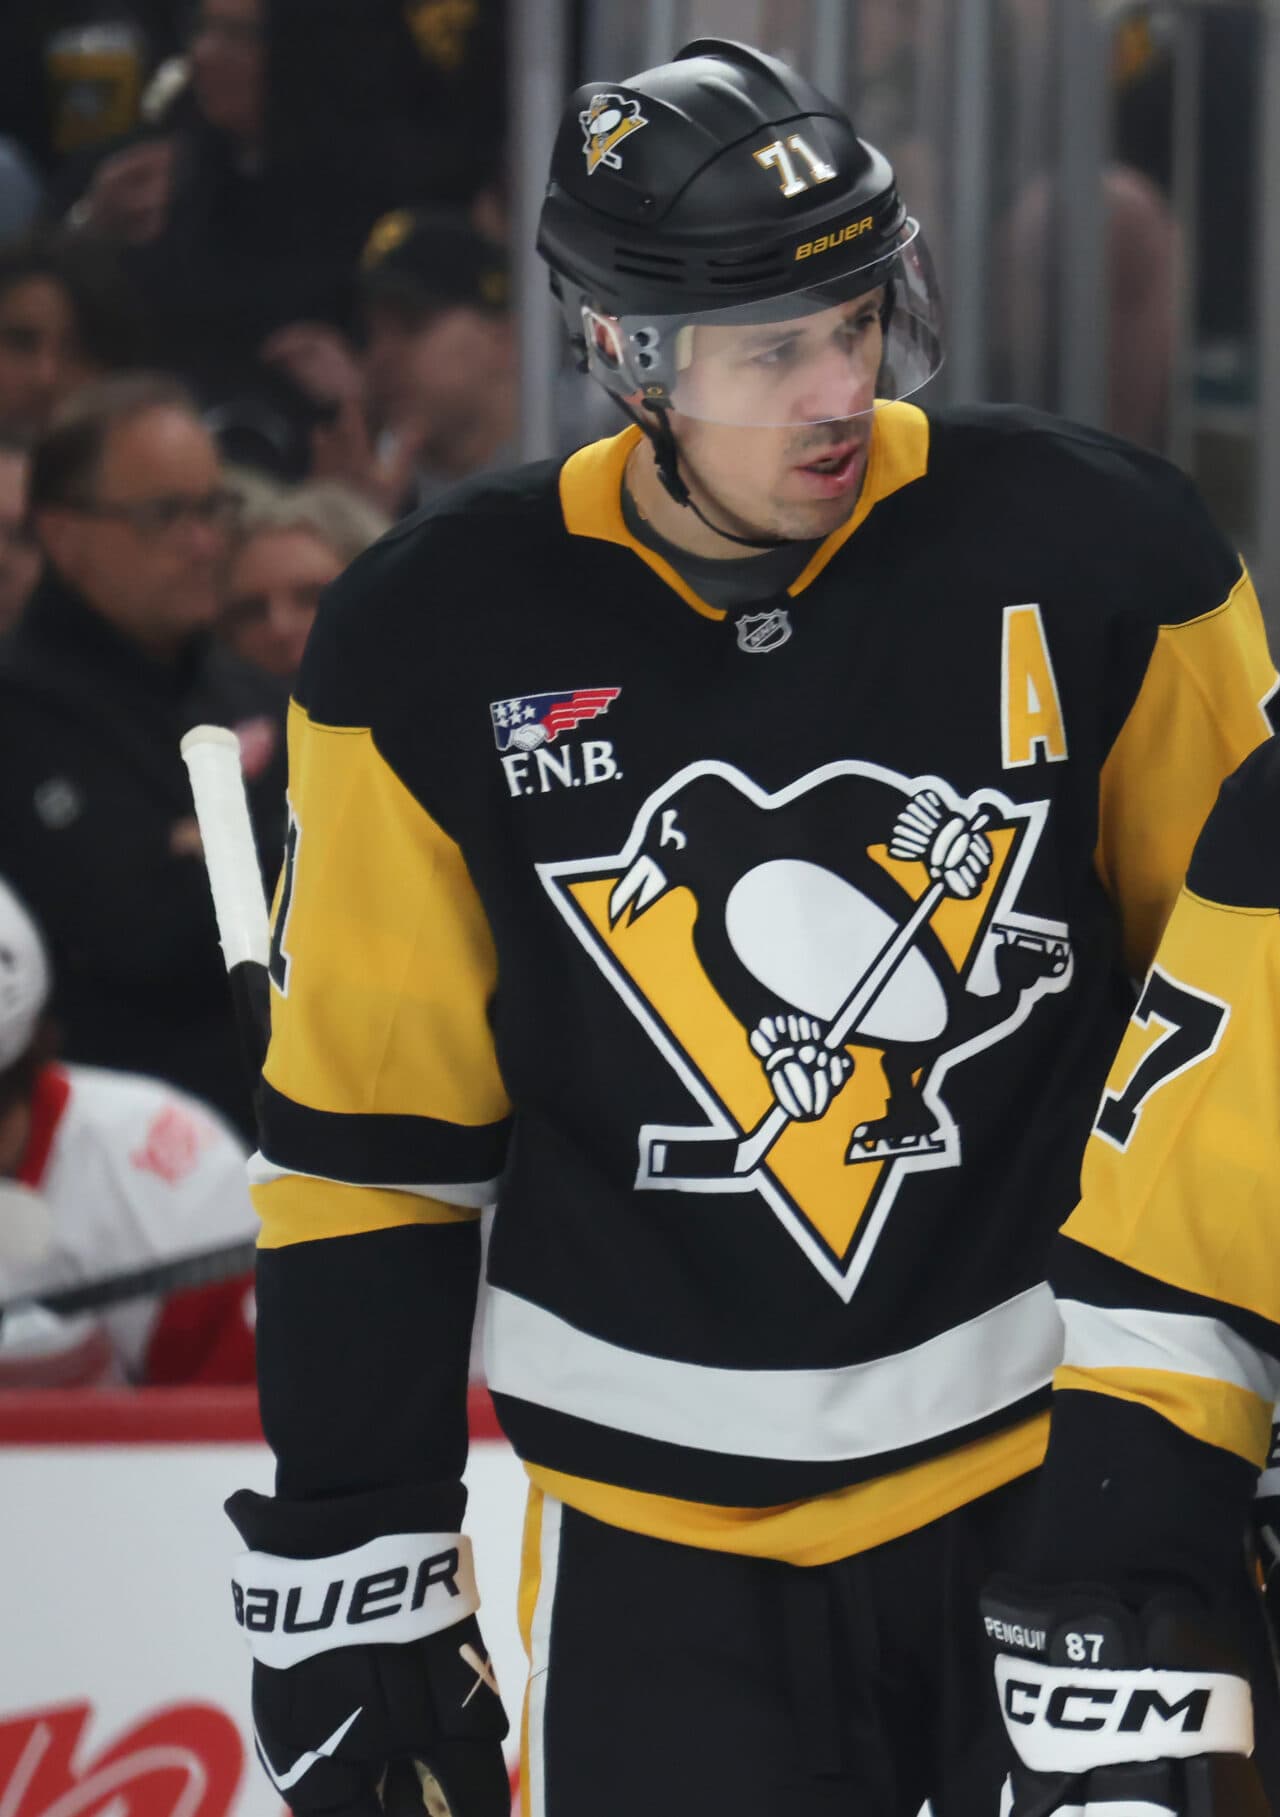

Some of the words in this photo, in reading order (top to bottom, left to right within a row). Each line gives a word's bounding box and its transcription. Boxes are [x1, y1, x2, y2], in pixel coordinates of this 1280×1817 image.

[752, 133, 838, 198] 71
[1001, 603, 1068, 769] A
[500, 740, 623, 797] F.N.B.
[1064, 1632, 1104, 1663] 87
[1005, 1678, 1213, 1733] CCM
